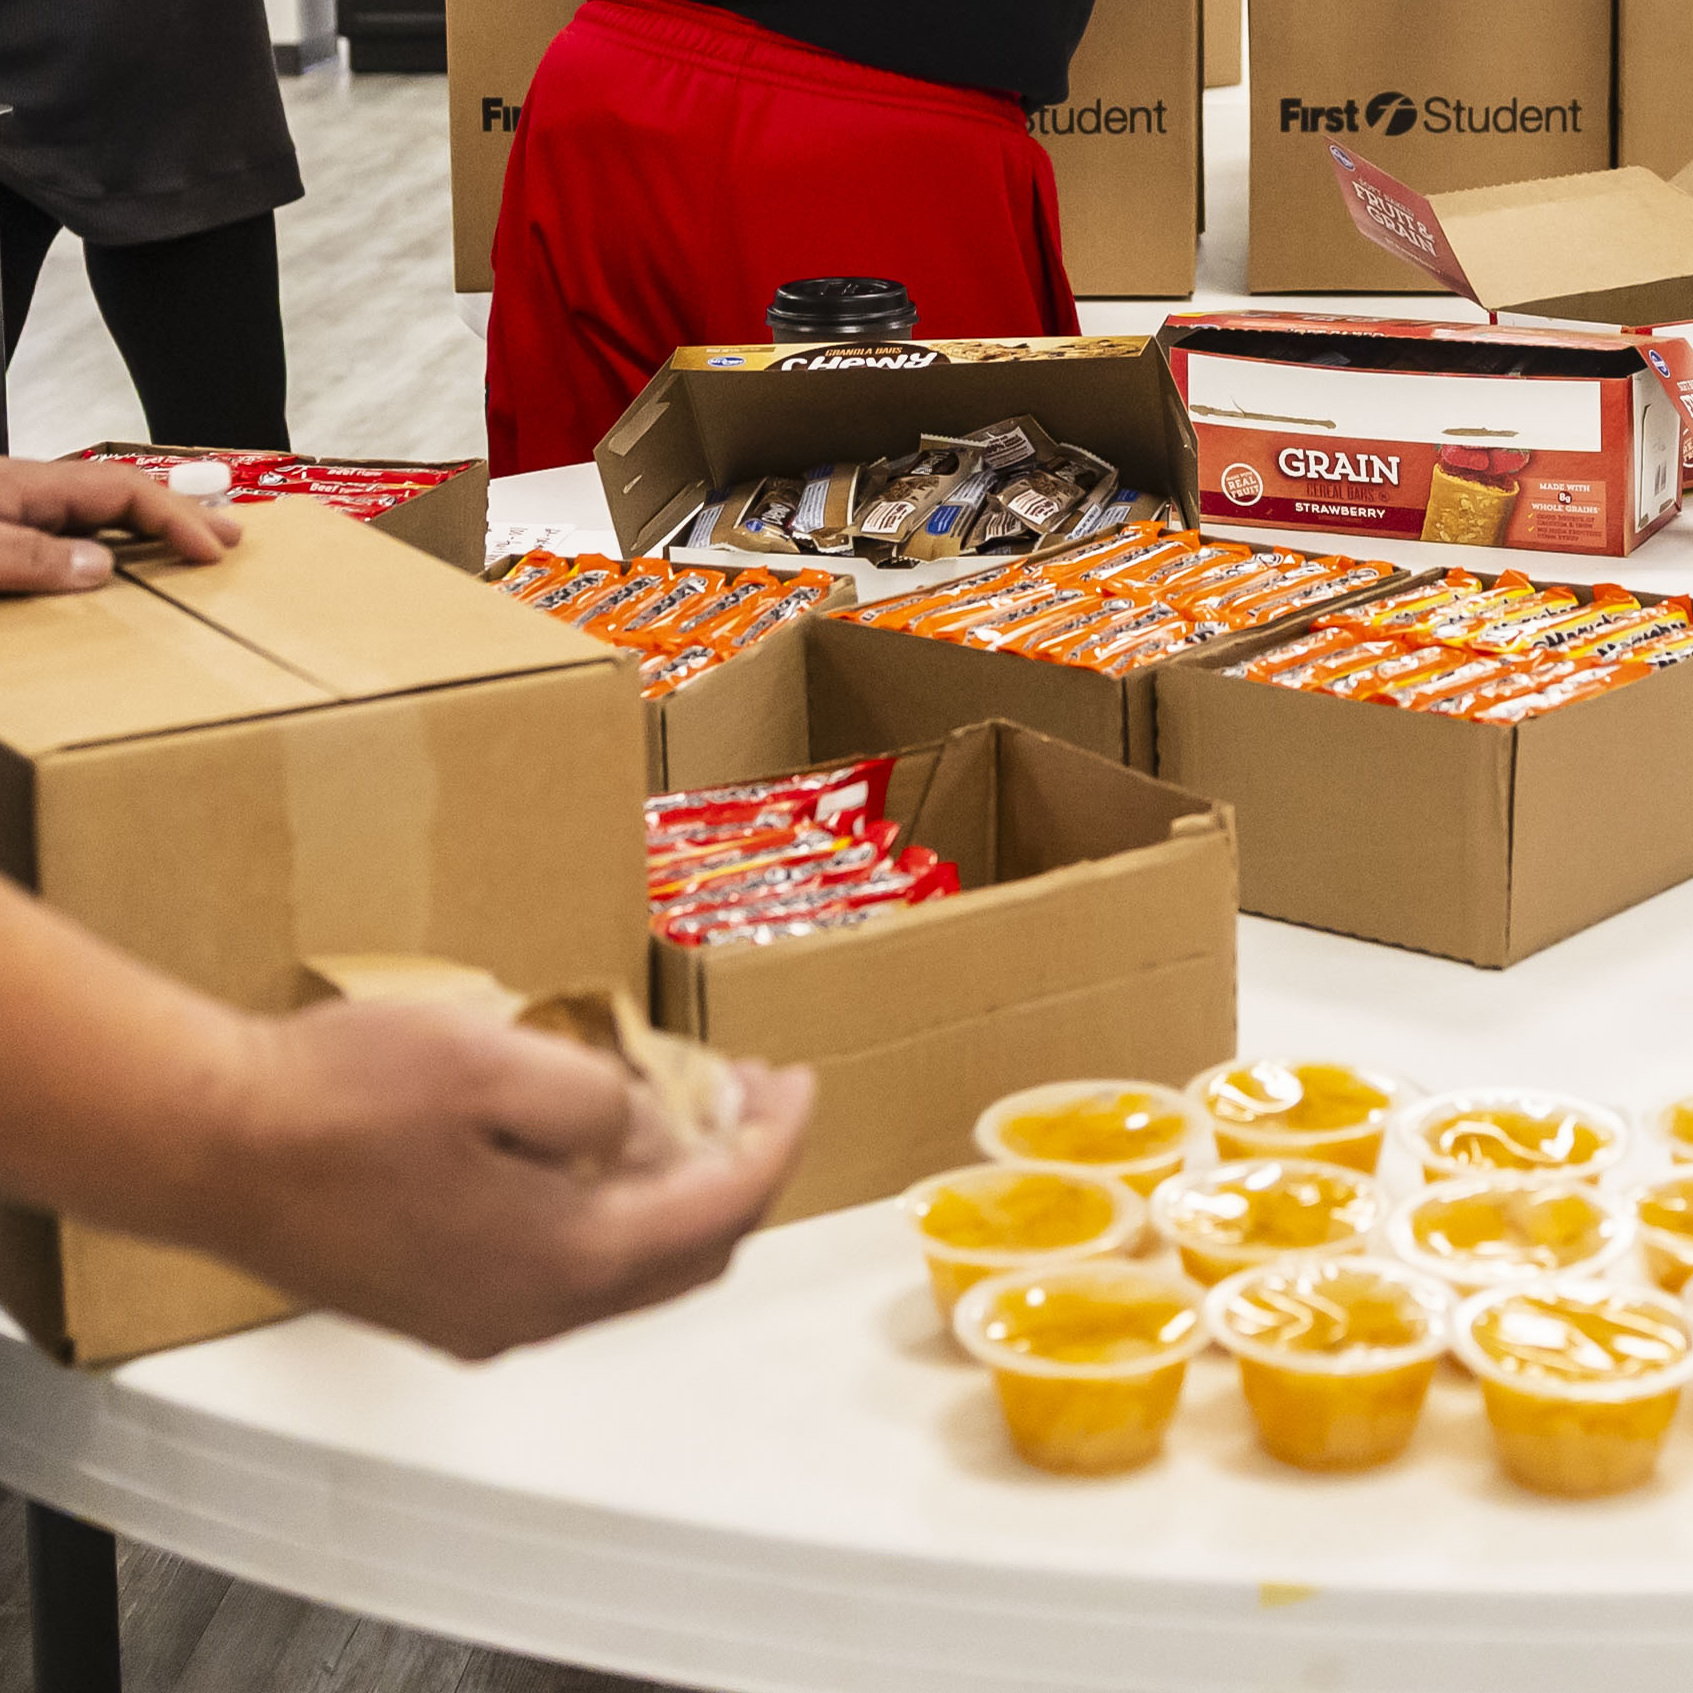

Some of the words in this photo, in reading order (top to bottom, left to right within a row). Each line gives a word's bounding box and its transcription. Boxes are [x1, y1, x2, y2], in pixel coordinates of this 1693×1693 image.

[1280, 98, 1360, 133] First
[1424, 97, 1583, 134] Student
[1352, 180, 1415, 231] FRUIT
[1366, 205, 1437, 257] GRAIN
[1278, 447, 1400, 485] GRAIN
[1227, 476, 1256, 490] REAL
[1539, 483, 1564, 491] MADE
[1567, 484, 1590, 492] WITH
[1230, 485, 1259, 499] FRUIT
[1295, 502, 1385, 519] STRAWBERRY
[1532, 503, 1563, 512] WHOLE
[1565, 505, 1598, 514] GRAINS
